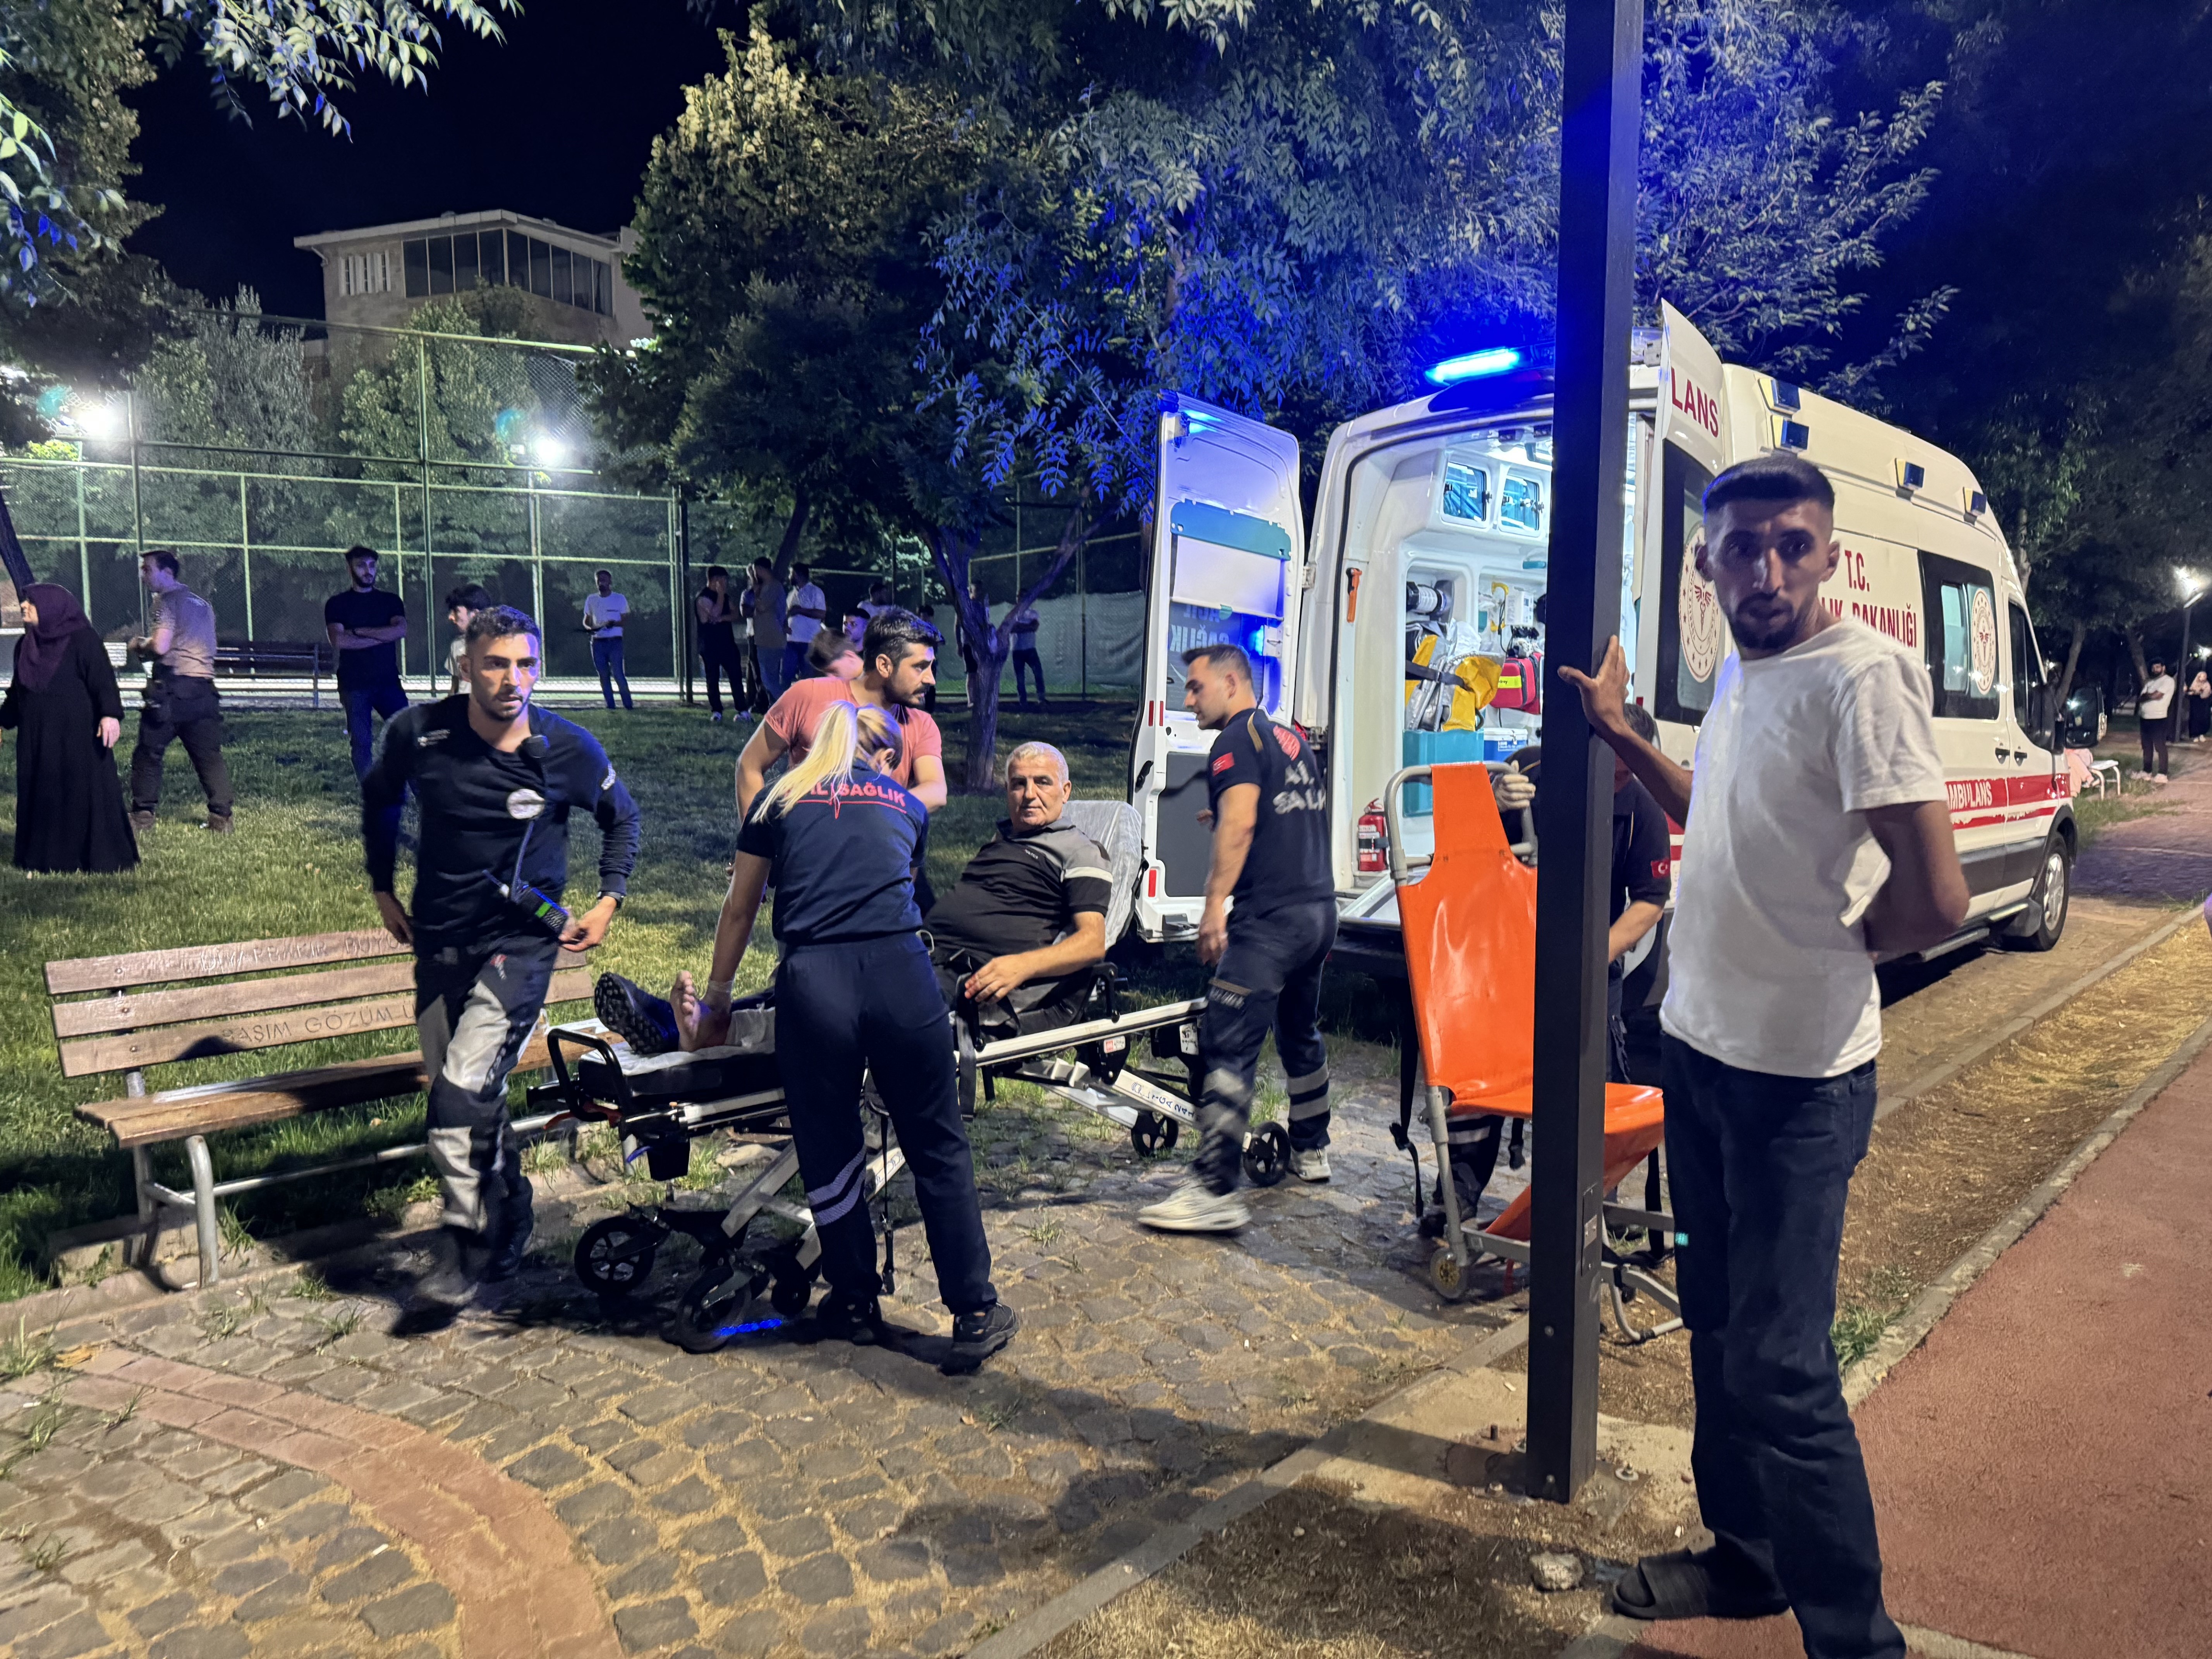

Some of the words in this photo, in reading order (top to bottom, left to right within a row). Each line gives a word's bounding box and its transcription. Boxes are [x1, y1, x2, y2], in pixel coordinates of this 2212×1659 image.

[1671, 366, 1719, 438] LANS
[1844, 549, 1870, 592] T.C.
[1946, 781, 1993, 810] MBULANS
[305, 1005, 394, 1034] GÖZÜM
